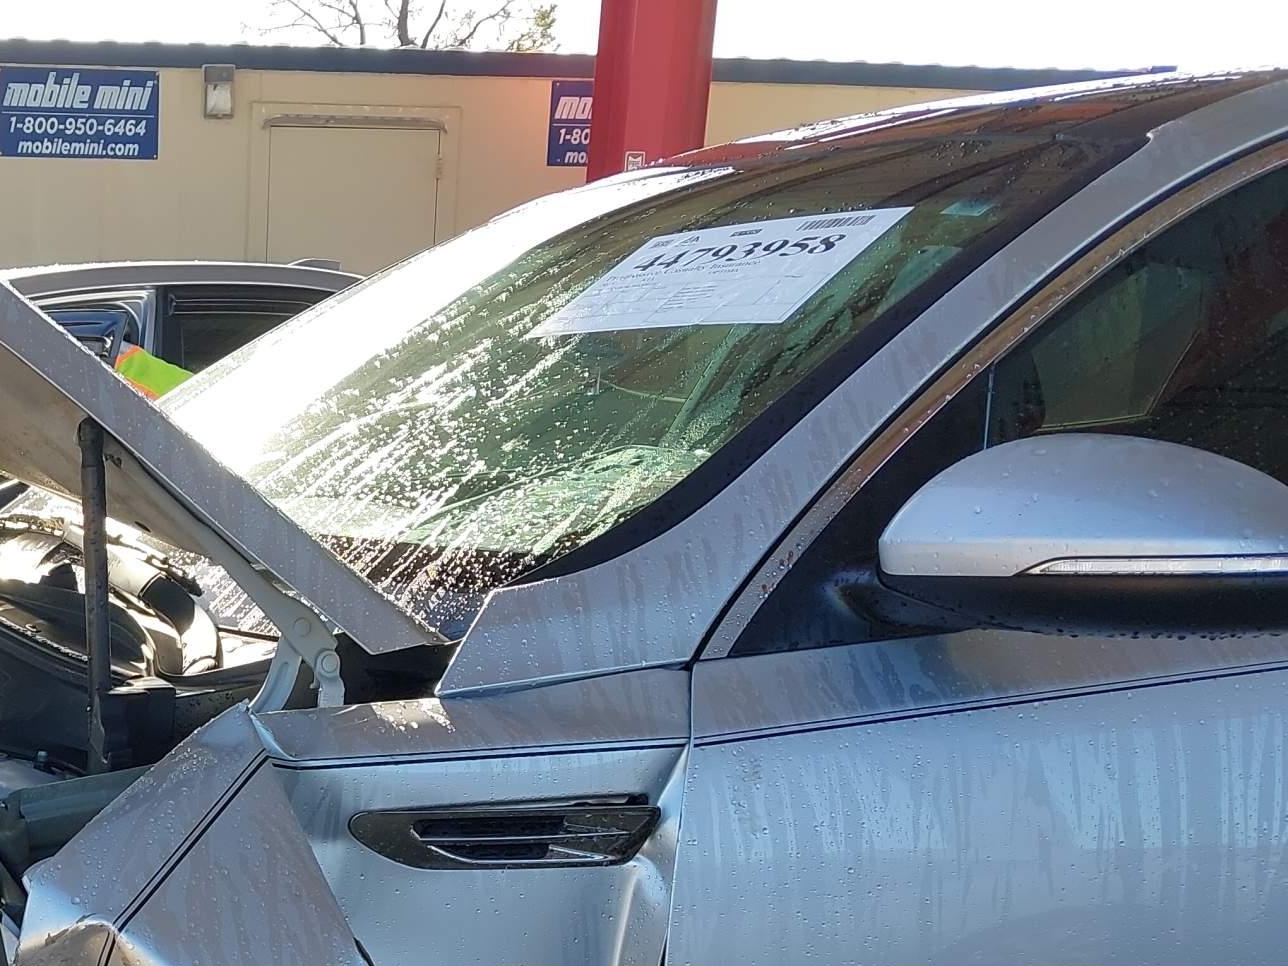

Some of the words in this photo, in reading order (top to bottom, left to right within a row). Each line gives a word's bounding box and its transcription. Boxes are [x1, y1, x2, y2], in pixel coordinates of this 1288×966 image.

[3, 71, 92, 109] mobile
[93, 79, 154, 111] mini
[9, 116, 147, 136] 1-800-950-6464
[17, 138, 140, 156] mobilemini.com
[633, 233, 847, 272] 44793958
